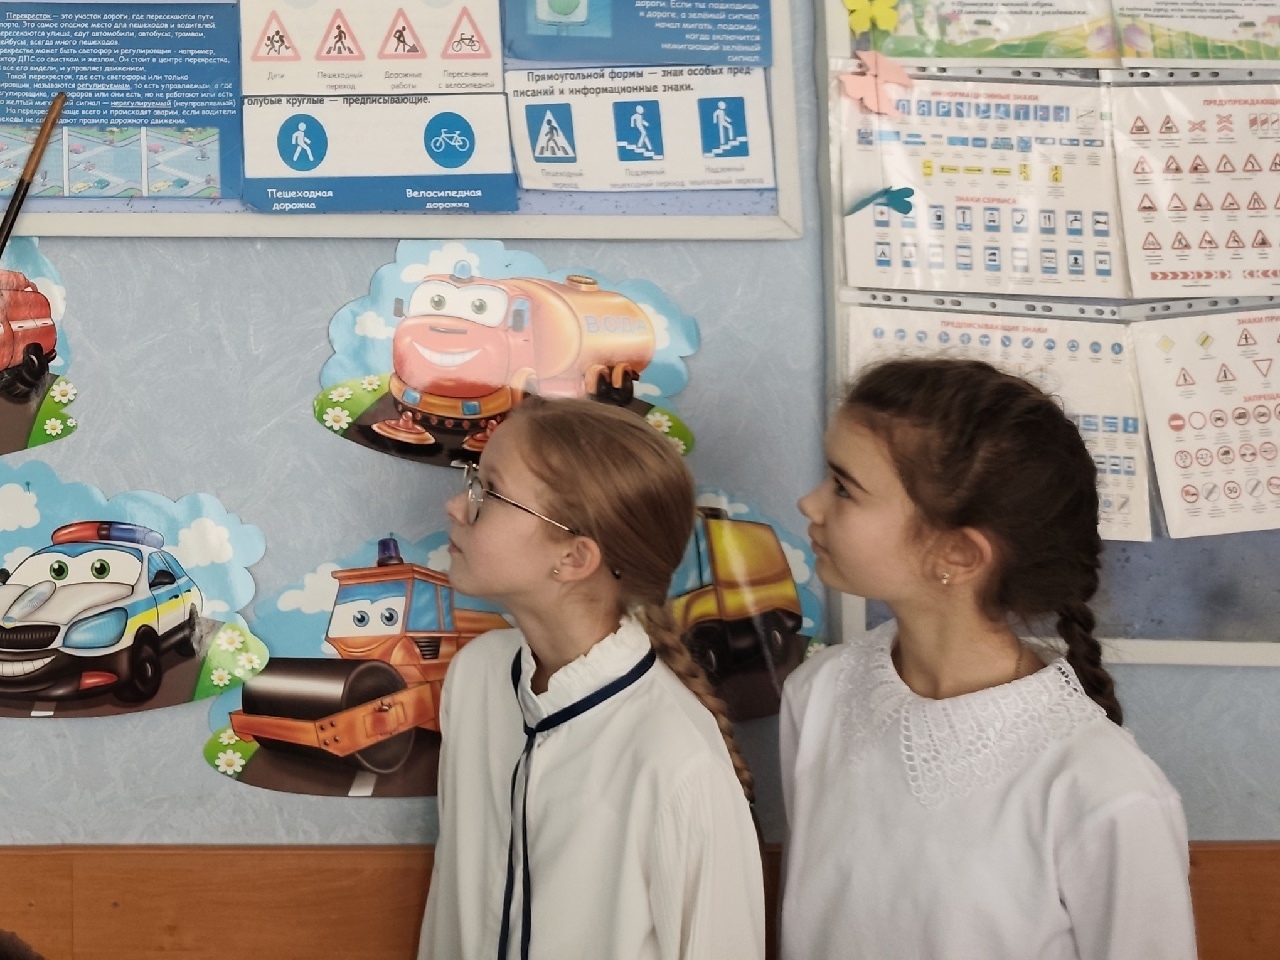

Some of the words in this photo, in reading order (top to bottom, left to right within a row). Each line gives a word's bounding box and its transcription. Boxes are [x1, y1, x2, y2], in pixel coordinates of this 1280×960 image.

[527, 69, 605, 84] Прямоугольной
[608, 69, 644, 82] формы
[661, 68, 684, 78] знак
[687, 65, 724, 77] особых
[513, 86, 555, 98] писаний
[568, 83, 659, 98] информационные
[662, 82, 694, 93] знаки.
[286, 96, 324, 107] круглые
[342, 95, 431, 106] предписывающие.
[267, 188, 333, 198] Пешеходная
[406, 188, 482, 199] Велосипедная
[272, 201, 316, 211] дорожка
[425, 201, 470, 211] дорожка
[584, 315, 648, 333] ВОДА
